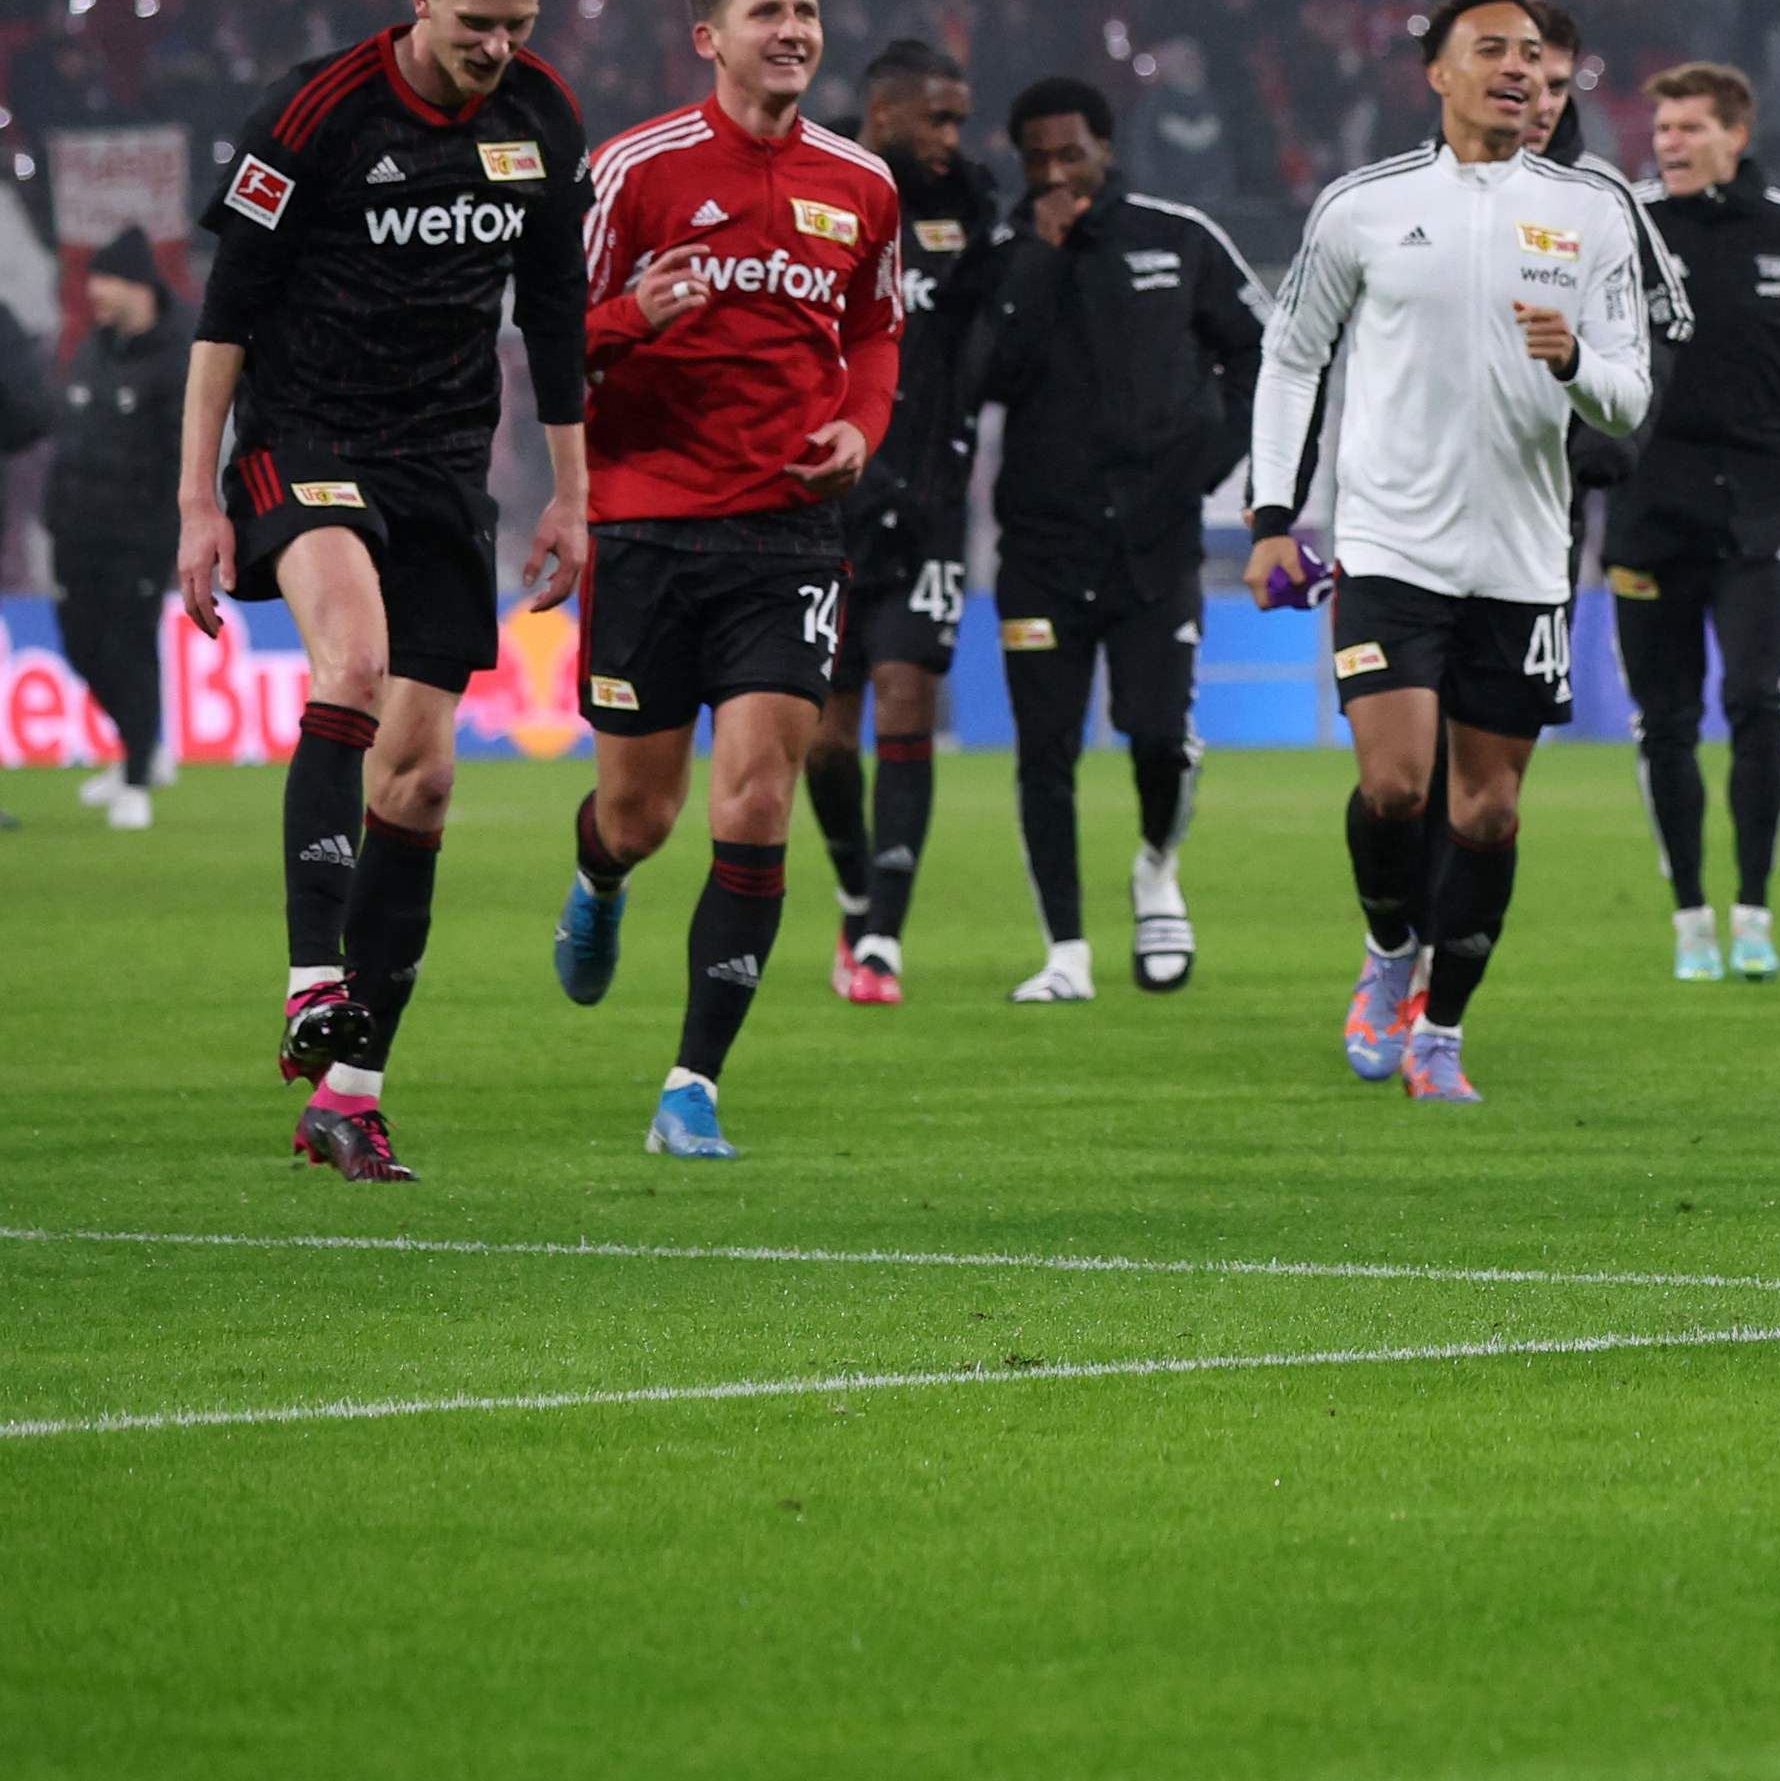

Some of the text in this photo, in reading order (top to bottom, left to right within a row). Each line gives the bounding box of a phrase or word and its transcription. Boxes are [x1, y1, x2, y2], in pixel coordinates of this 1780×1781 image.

[365, 191, 526, 245] wefox
[690, 249, 837, 304] wefox
[909, 559, 965, 623] 45
[1523, 606, 1570, 684] 40
